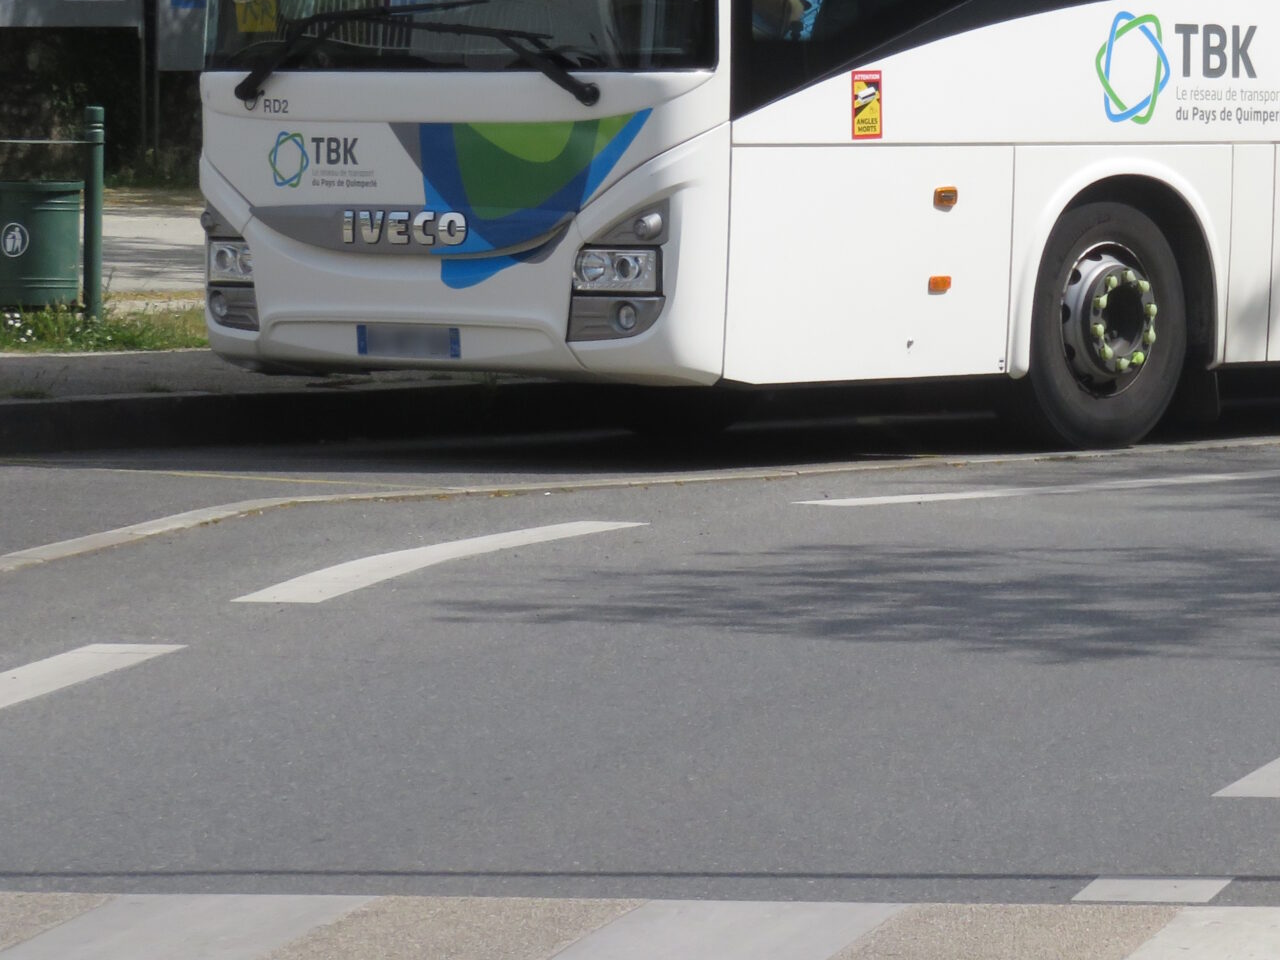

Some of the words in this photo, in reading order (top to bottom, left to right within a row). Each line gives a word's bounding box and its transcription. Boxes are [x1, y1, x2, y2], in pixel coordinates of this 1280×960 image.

[1175, 24, 1258, 79] TBK
[1176, 86, 1187, 101] Le
[1190, 86, 1223, 101] réseau
[1226, 87, 1237, 101] de
[264, 99, 289, 113] RD2
[1175, 106, 1189, 121] du
[1192, 107, 1217, 125] Pays
[1220, 107, 1233, 121] de
[311, 137, 359, 165] TBK
[321, 178, 336, 189] Pays
[337, 178, 345, 187] de
[343, 210, 468, 245] IVECO
